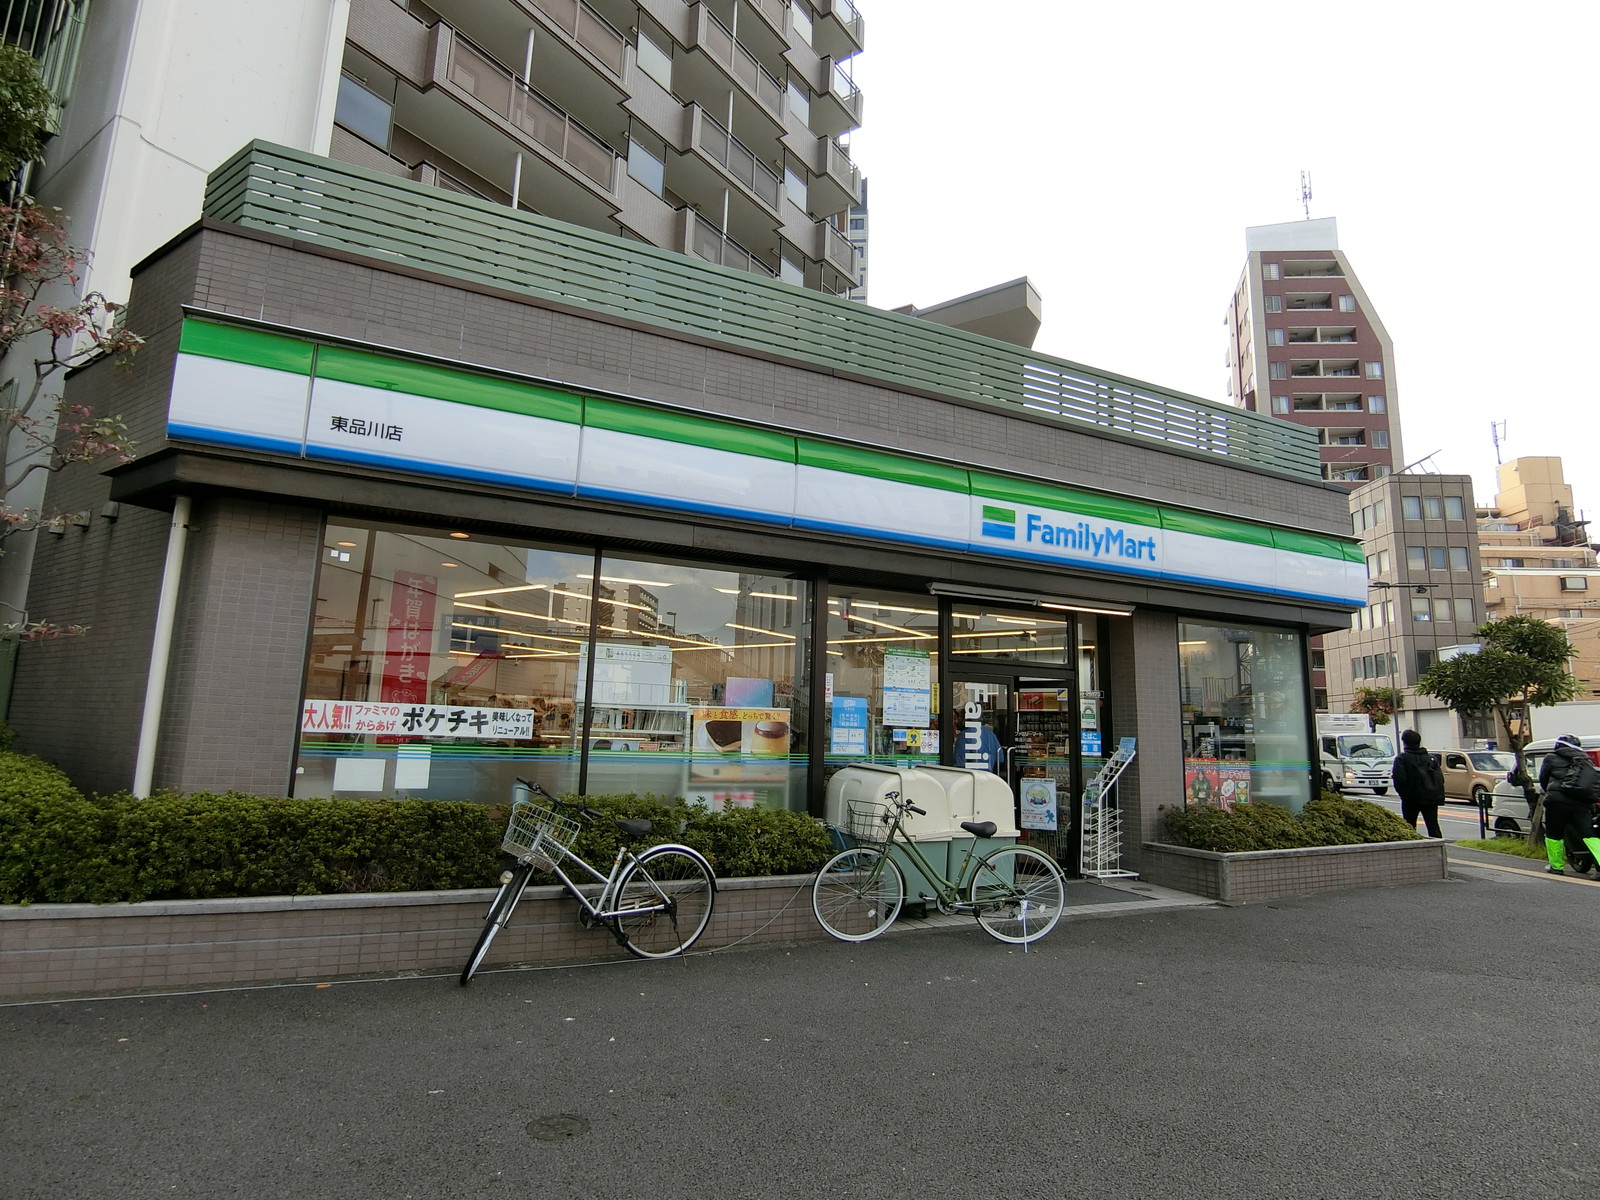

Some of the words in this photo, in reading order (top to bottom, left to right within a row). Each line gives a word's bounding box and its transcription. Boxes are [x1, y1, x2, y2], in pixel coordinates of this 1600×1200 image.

[330, 415, 403, 442] 東品川店
[1026, 513, 1156, 562] FamilyMart
[399, 577, 423, 684] 年賀はがき
[303, 703, 353, 731] 大人気!!
[354, 704, 400, 718] ファミマの
[401, 707, 490, 735] ポケチキ
[491, 711, 532, 724] 美味しくなって
[354, 719, 398, 732] からあげ
[492, 725, 531, 738] リニューアル!!
